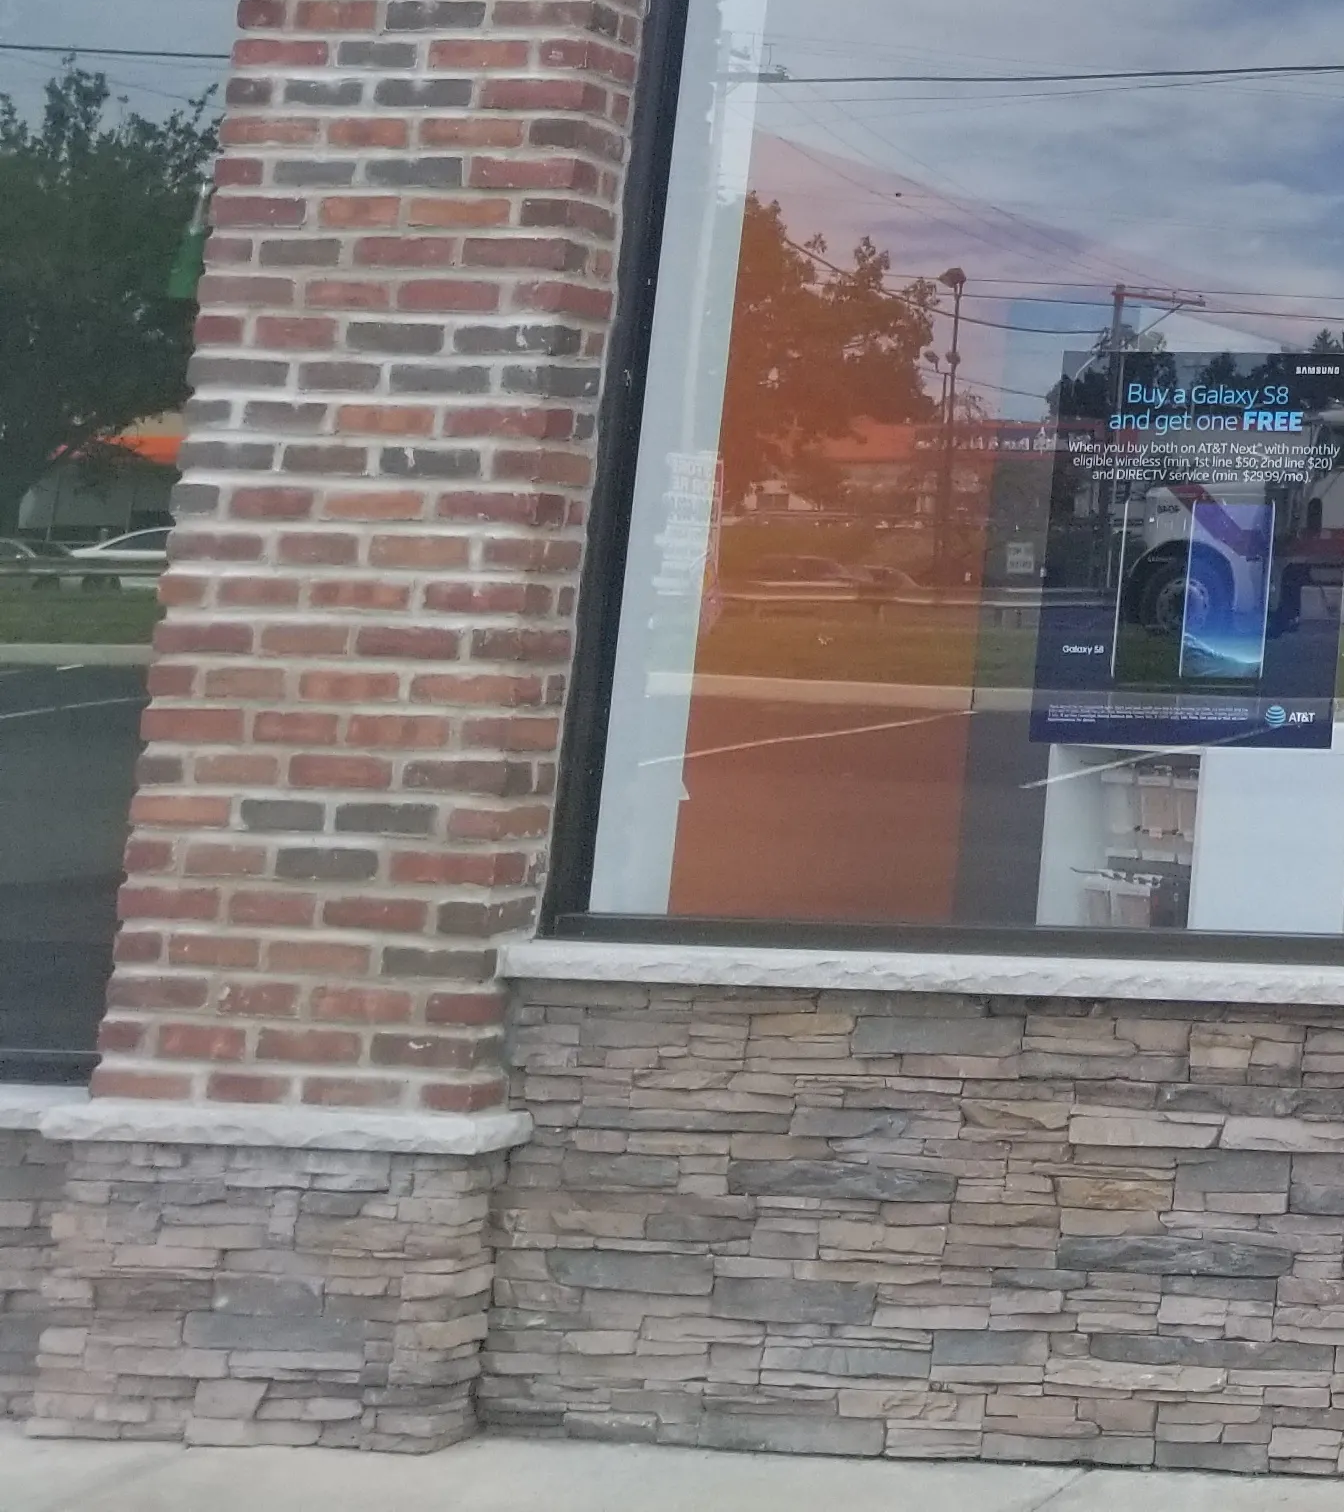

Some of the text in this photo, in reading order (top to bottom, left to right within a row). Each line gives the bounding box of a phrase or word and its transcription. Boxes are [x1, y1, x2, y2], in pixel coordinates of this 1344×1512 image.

[1296, 366, 1340, 375] SAMSUNG
[1127, 383, 1289, 409] Buy a Galaxy S8
[1109, 409, 1304, 435] and get one FREE
[1069, 441, 1101, 453] When
[1104, 443, 1125, 458] you
[1128, 441, 1149, 458] buy
[1151, 441, 1178, 454] both
[1181, 444, 1196, 454] on
[1198, 443, 1228, 454] AT&T
[1264, 443, 1290, 455] with
[1292, 443, 1341, 458] monthly
[1073, 454, 1113, 469] eligible
[1115, 455, 1161, 467] wireless
[1212, 456, 1233, 468] line
[1261, 456, 1283, 469] 2nd
[1285, 456, 1305, 469] line
[1307, 457, 1333, 471] $20)
[1092, 468, 1115, 481] and
[1116, 469, 1167, 481] DIRECTV
[1169, 469, 1210, 481] service
[1062, 644, 1092, 655] Galaxy
[1288, 712, 1316, 724] AT&T
